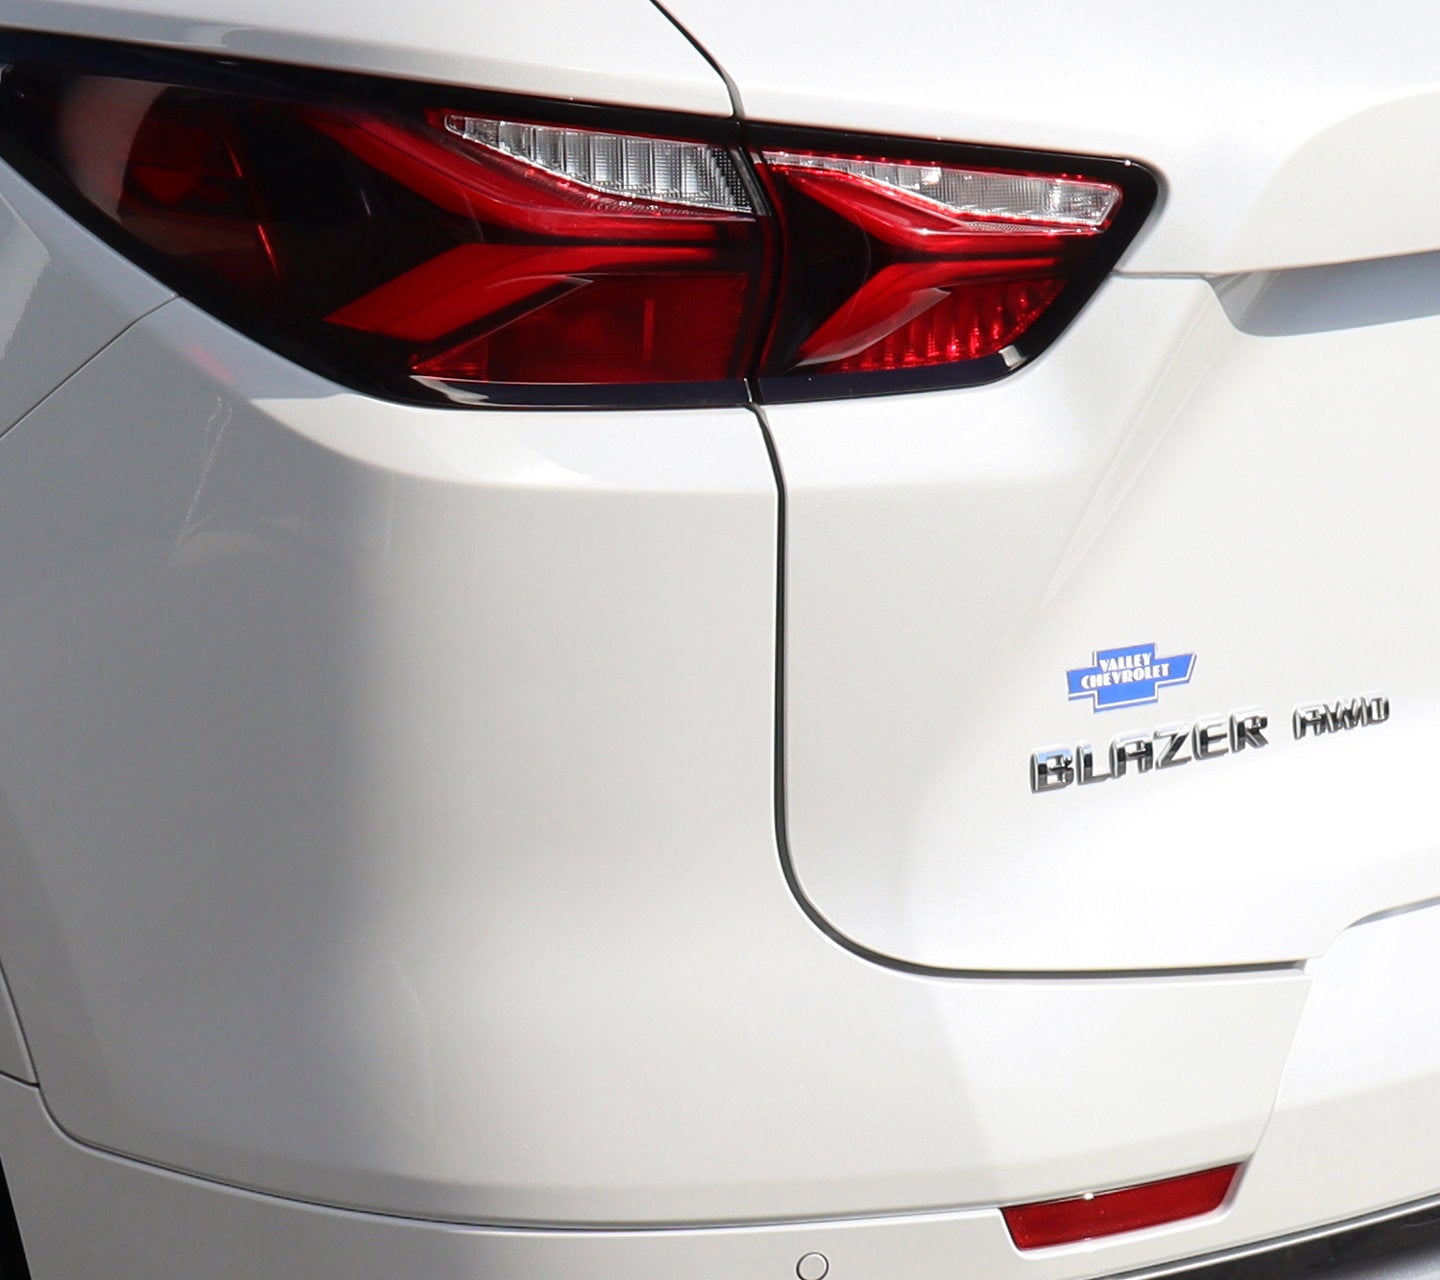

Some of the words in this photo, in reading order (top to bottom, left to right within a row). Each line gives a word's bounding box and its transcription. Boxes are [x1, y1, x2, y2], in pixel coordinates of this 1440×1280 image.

[1099, 652, 1152, 673] VALLEY
[1080, 663, 1170, 690] CHEVROLET
[1028, 705, 1269, 794] BLAZER
[1292, 688, 1391, 740] AWD
